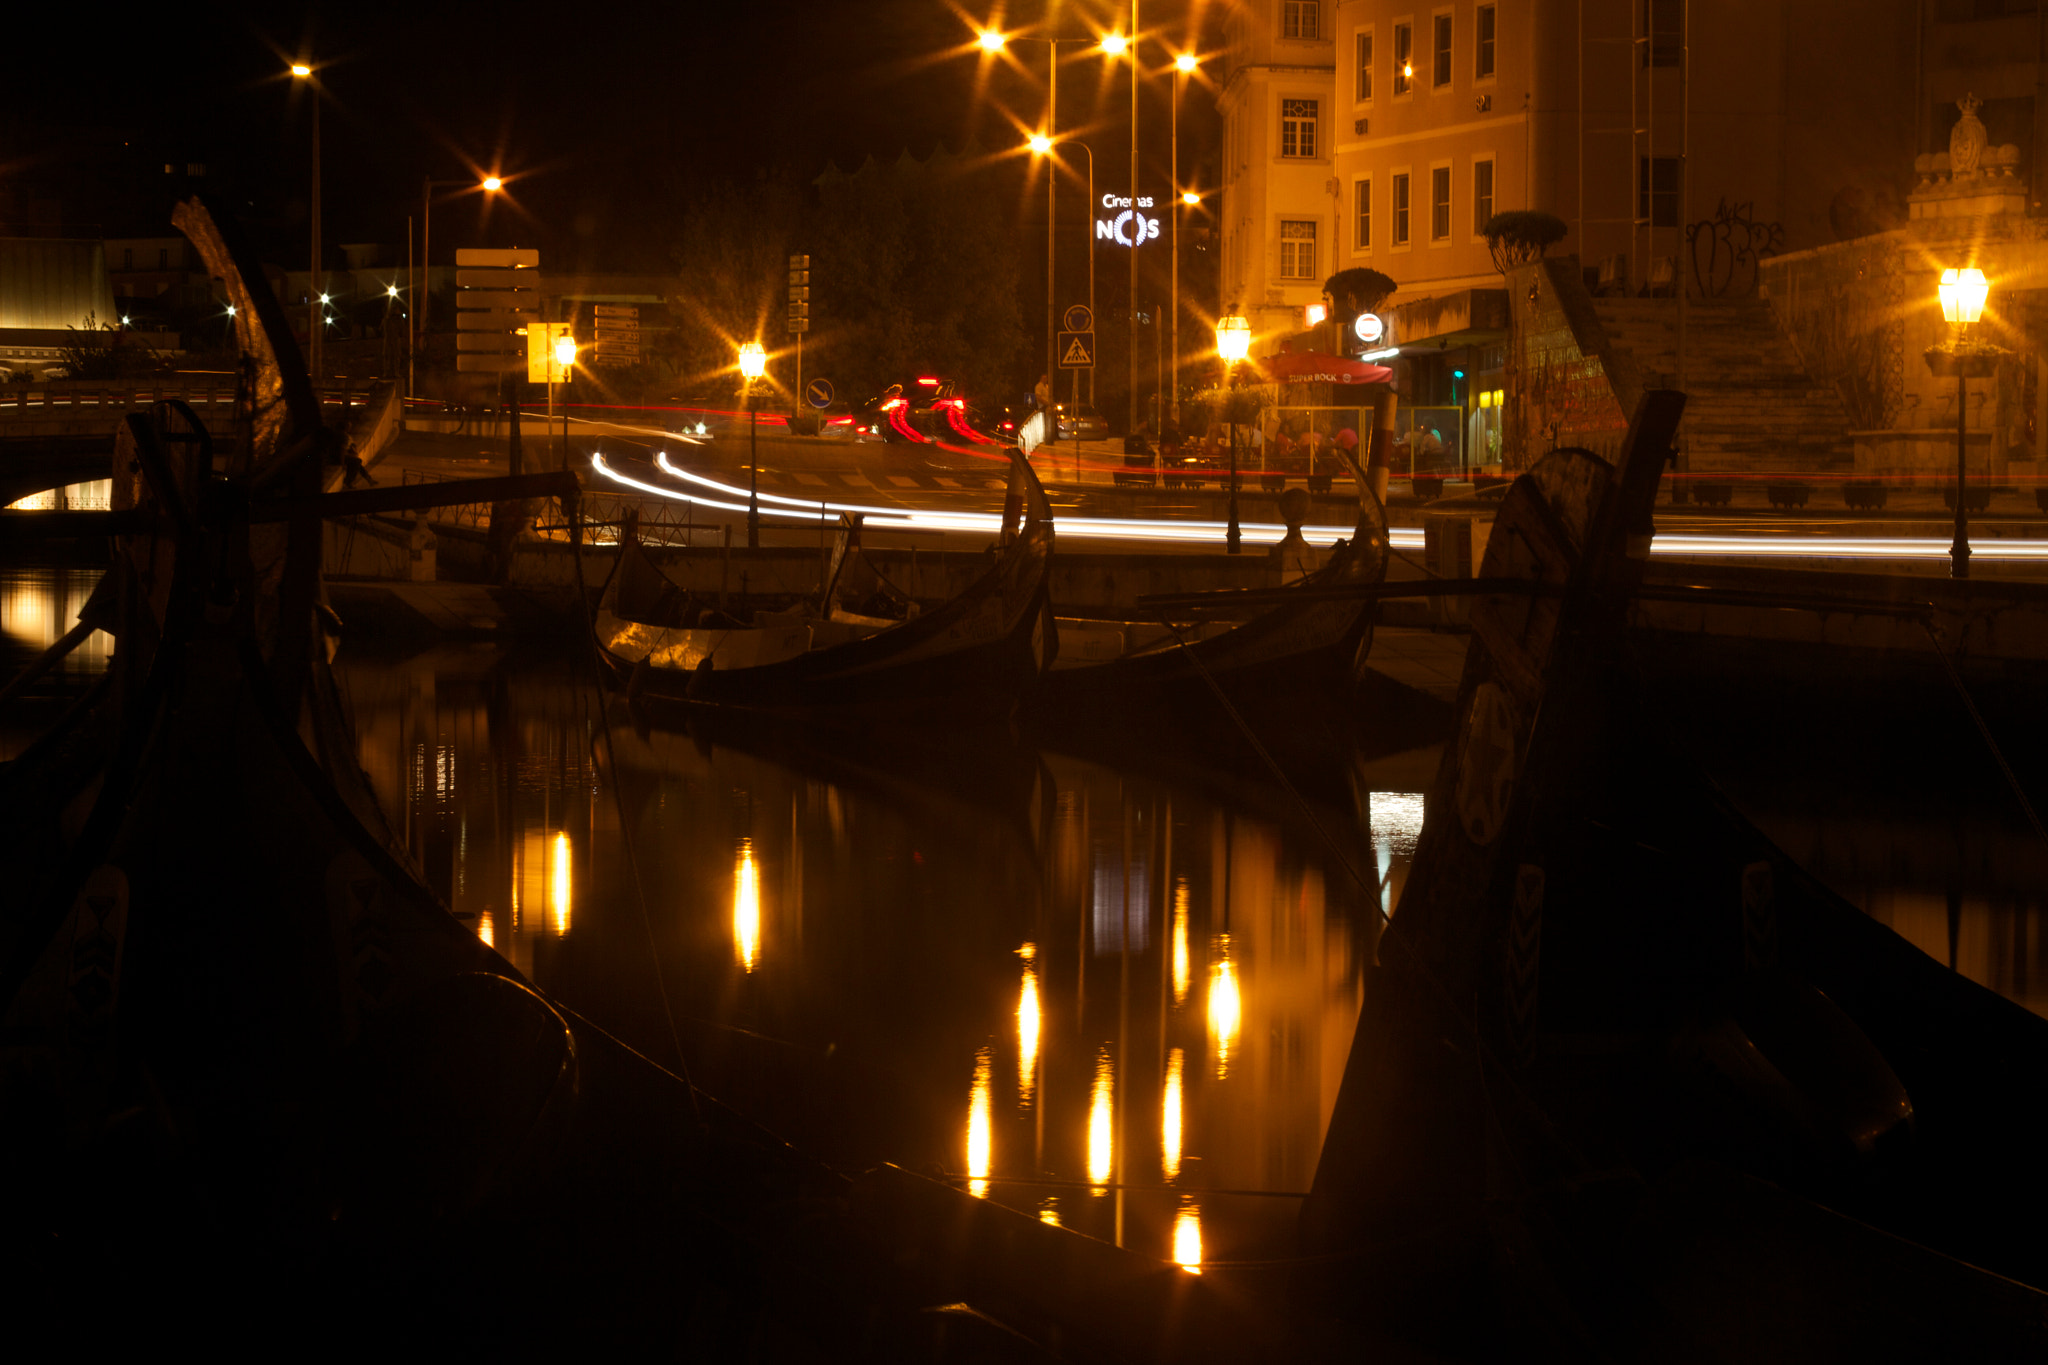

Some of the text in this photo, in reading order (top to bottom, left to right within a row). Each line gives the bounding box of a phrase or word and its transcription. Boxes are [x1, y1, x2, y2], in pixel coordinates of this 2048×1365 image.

[1102, 193, 1154, 208] Cinemas
[1096, 209, 1160, 248] NOS
[1288, 374, 1313, 383] SUPER
[1314, 372, 1337, 382] BOCK
